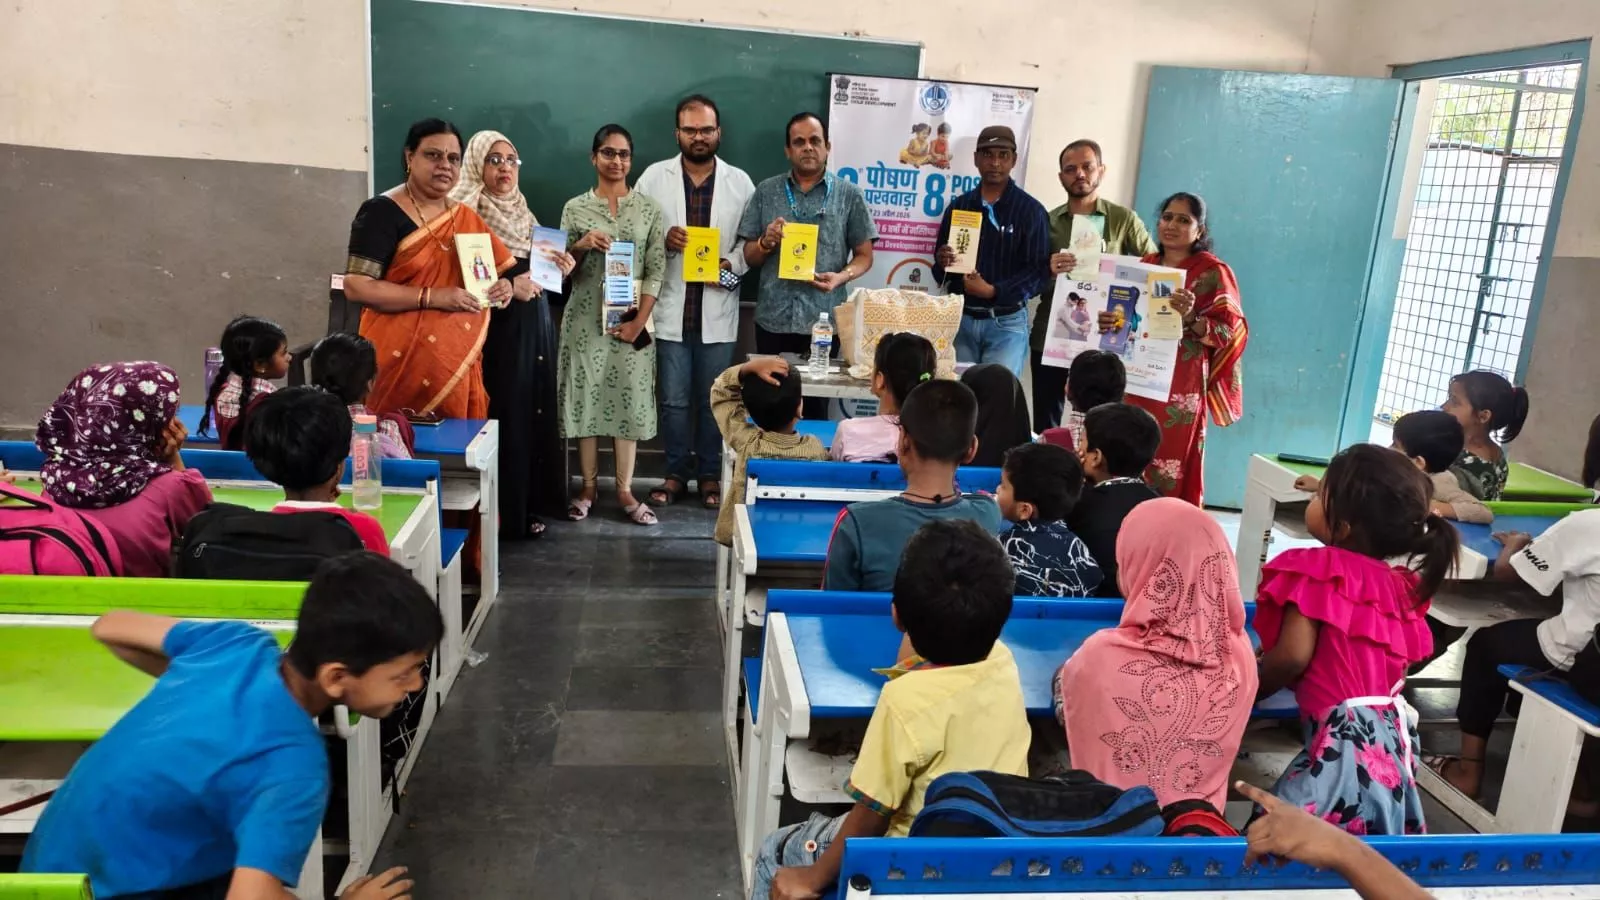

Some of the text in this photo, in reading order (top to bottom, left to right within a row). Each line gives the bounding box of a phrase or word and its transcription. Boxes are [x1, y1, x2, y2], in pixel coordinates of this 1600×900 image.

[866, 161, 920, 190] पोषण
[864, 189, 918, 210] पखवाड़ा
[923, 173, 945, 217] 8
[882, 223, 888, 233] 6
[885, 240, 925, 251] Development
